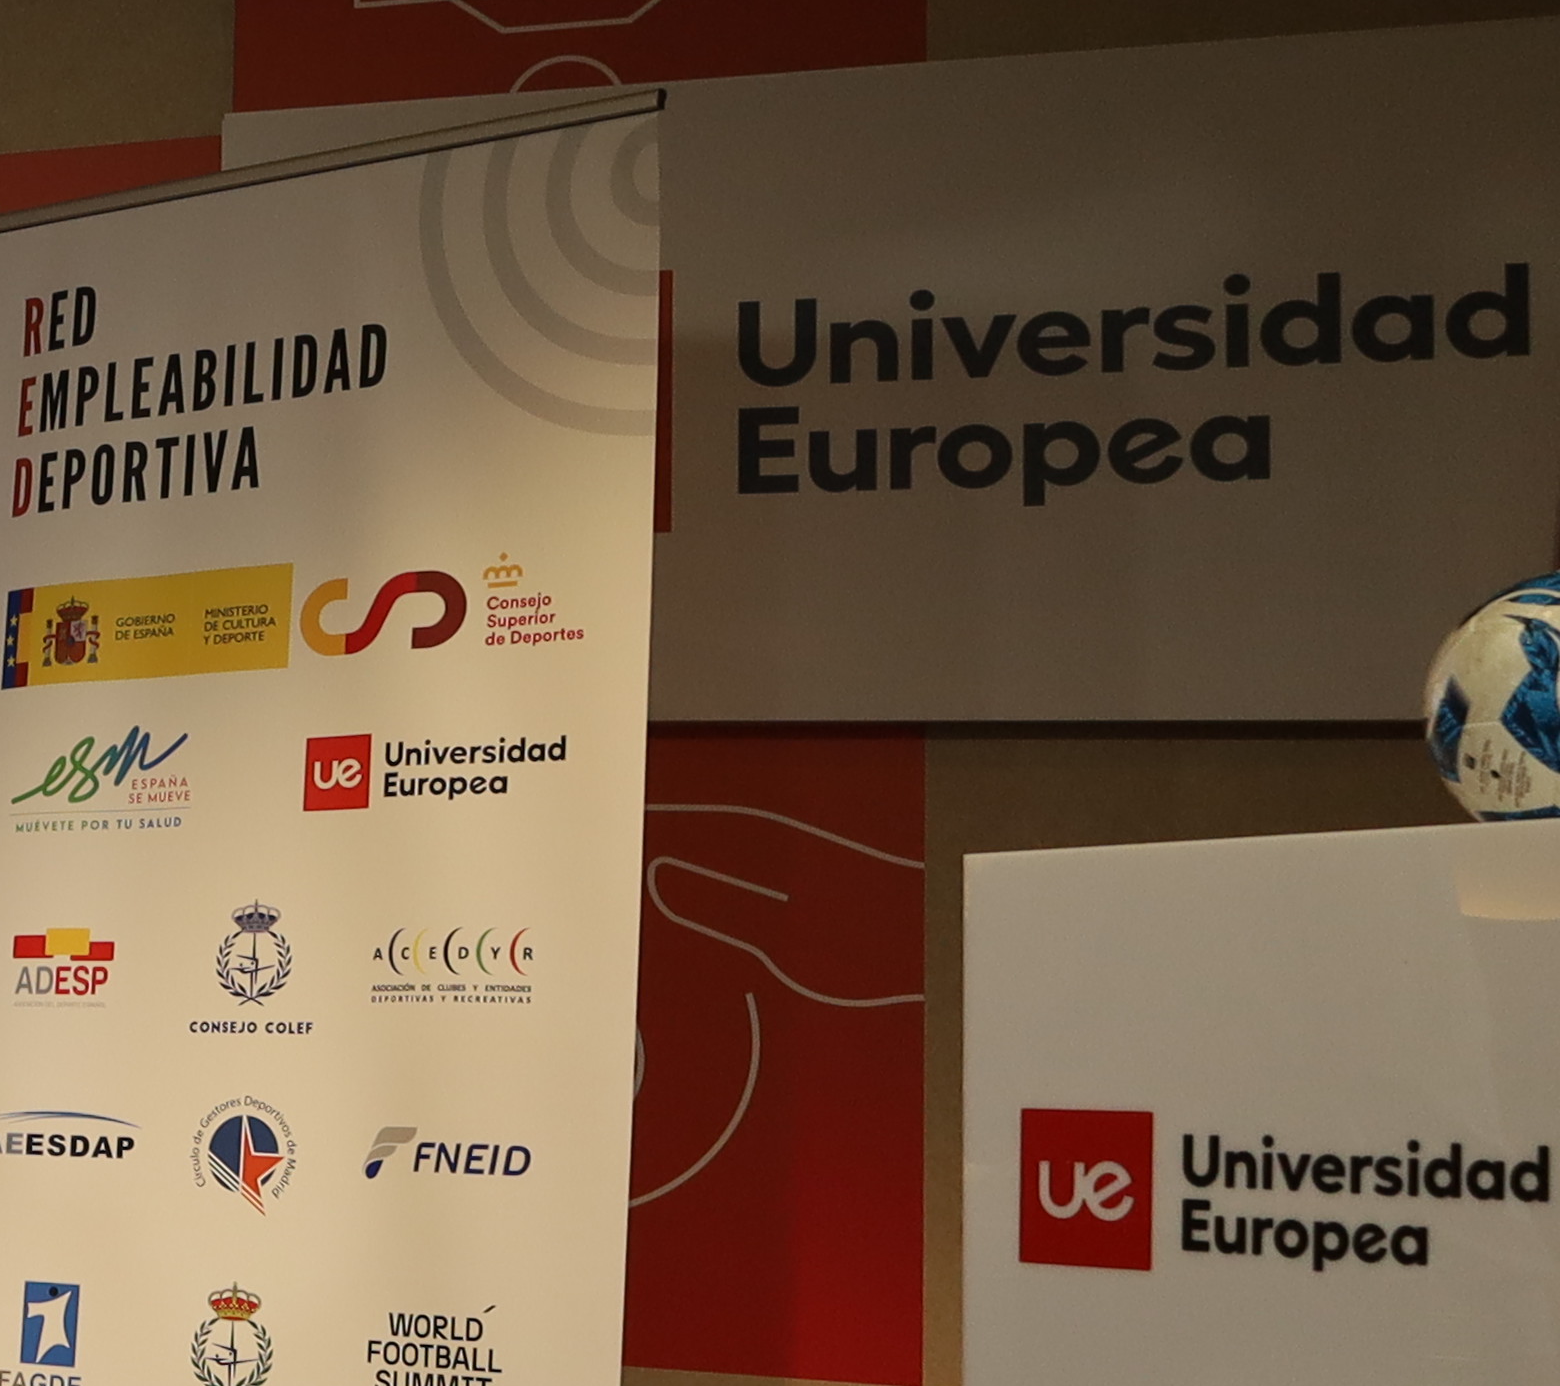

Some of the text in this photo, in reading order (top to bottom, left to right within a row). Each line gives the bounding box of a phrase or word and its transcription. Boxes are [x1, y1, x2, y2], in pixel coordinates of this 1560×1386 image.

[23, 286, 96, 357] RED
[737, 262, 1531, 388] Universidad
[18, 323, 387, 438] EMPLEABILIDAD
[12, 426, 260, 518] DEPORTIVA
[737, 406, 1271, 508] Europea
[204, 604, 269, 619] MINISTERIO
[486, 592, 552, 613] Consejo
[114, 625, 174, 641] DE ESPAÑA
[115, 613, 176, 628] GOBIERNO
[203, 616, 277, 633] DE CULTURA
[486, 610, 556, 630] Superior
[203, 630, 265, 646] Y DEPORTE
[485, 627, 585, 647] de Deportes
[384, 734, 567, 767] Universidad
[131, 774, 189, 791] ESPAÑA
[313, 758, 363, 790] ue
[383, 771, 508, 801] Europea
[128, 790, 191, 805] SE MUEVE
[15, 816, 182, 833] MUÉVETE POR TU SALUD
[15, 965, 109, 996] ADESP
[371, 983, 416, 993] ASOCIACIÓN
[421, 984, 431, 992] DE
[484, 984, 532, 993] ENTIDADES
[371, 995, 434, 1003] DEPORTIVAS
[453, 995, 532, 1004] RECREATIVAS
[189, 1021, 314, 1035] CONSEJO COLEF
[200, 1097, 242, 1129] Gestores
[244, 1095, 293, 1138] Deportivos
[271, 1158, 297, 1200] Madrid
[413, 1142, 532, 1176] FNEID
[1181, 1133, 1550, 1203] Universidad
[1038, 1159, 1134, 1222] ue
[1181, 1198, 1429, 1272] Europea
[389, 1312, 484, 1342] WORLD
[367, 1339, 503, 1374] FOOTBALL
